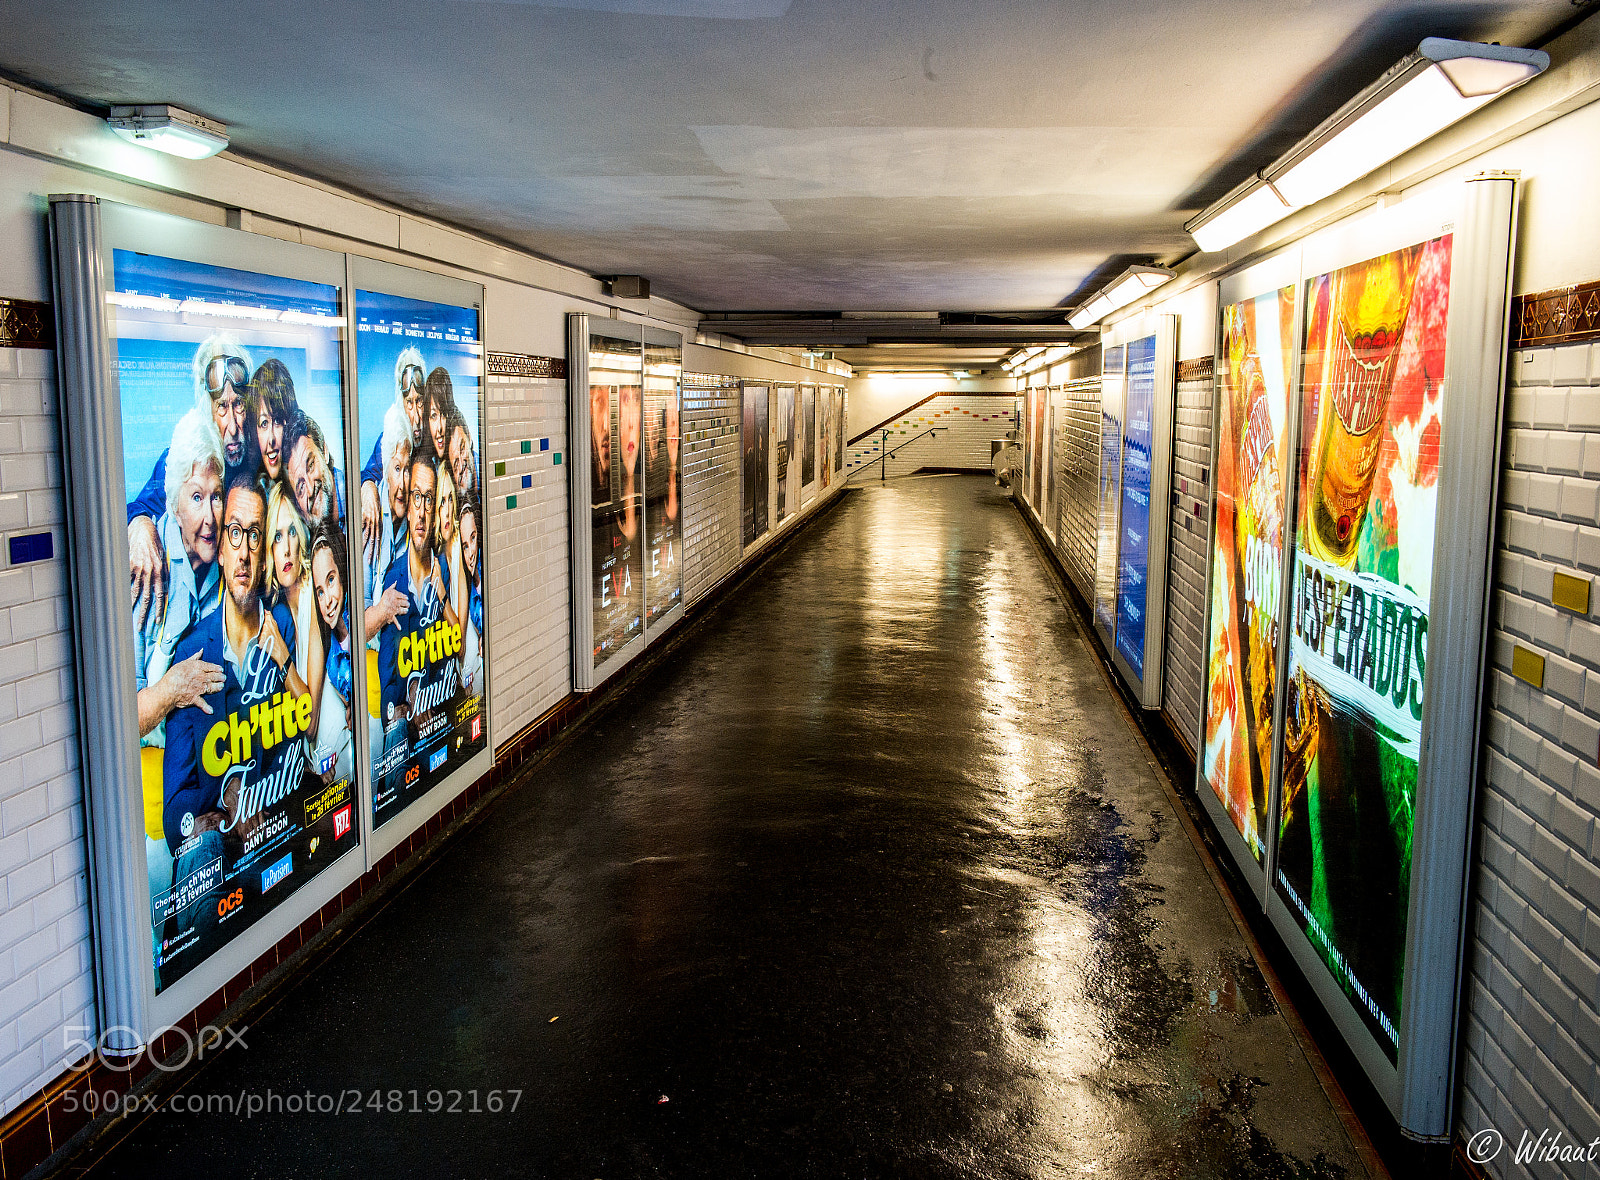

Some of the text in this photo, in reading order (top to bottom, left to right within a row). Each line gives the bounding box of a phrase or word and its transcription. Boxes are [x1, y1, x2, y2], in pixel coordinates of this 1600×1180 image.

[653, 541, 675, 578] EVA
[602, 564, 632, 608] EVA
[397, 619, 461, 678] Ch'tite
[1294, 556, 1428, 722] DESPERADOS
[241, 635, 277, 704] La
[406, 658, 458, 722] Famille
[202, 692, 313, 777] Ch'tite
[219, 739, 304, 833] Famille
[321, 778, 348, 803] nationale
[324, 791, 344, 811] février
[244, 829, 265, 854] DANY
[266, 815, 288, 839] BOON
[187, 877, 214, 902] février
[188, 859, 220, 889] ch'Nord
[217, 887, 244, 917] OCS
